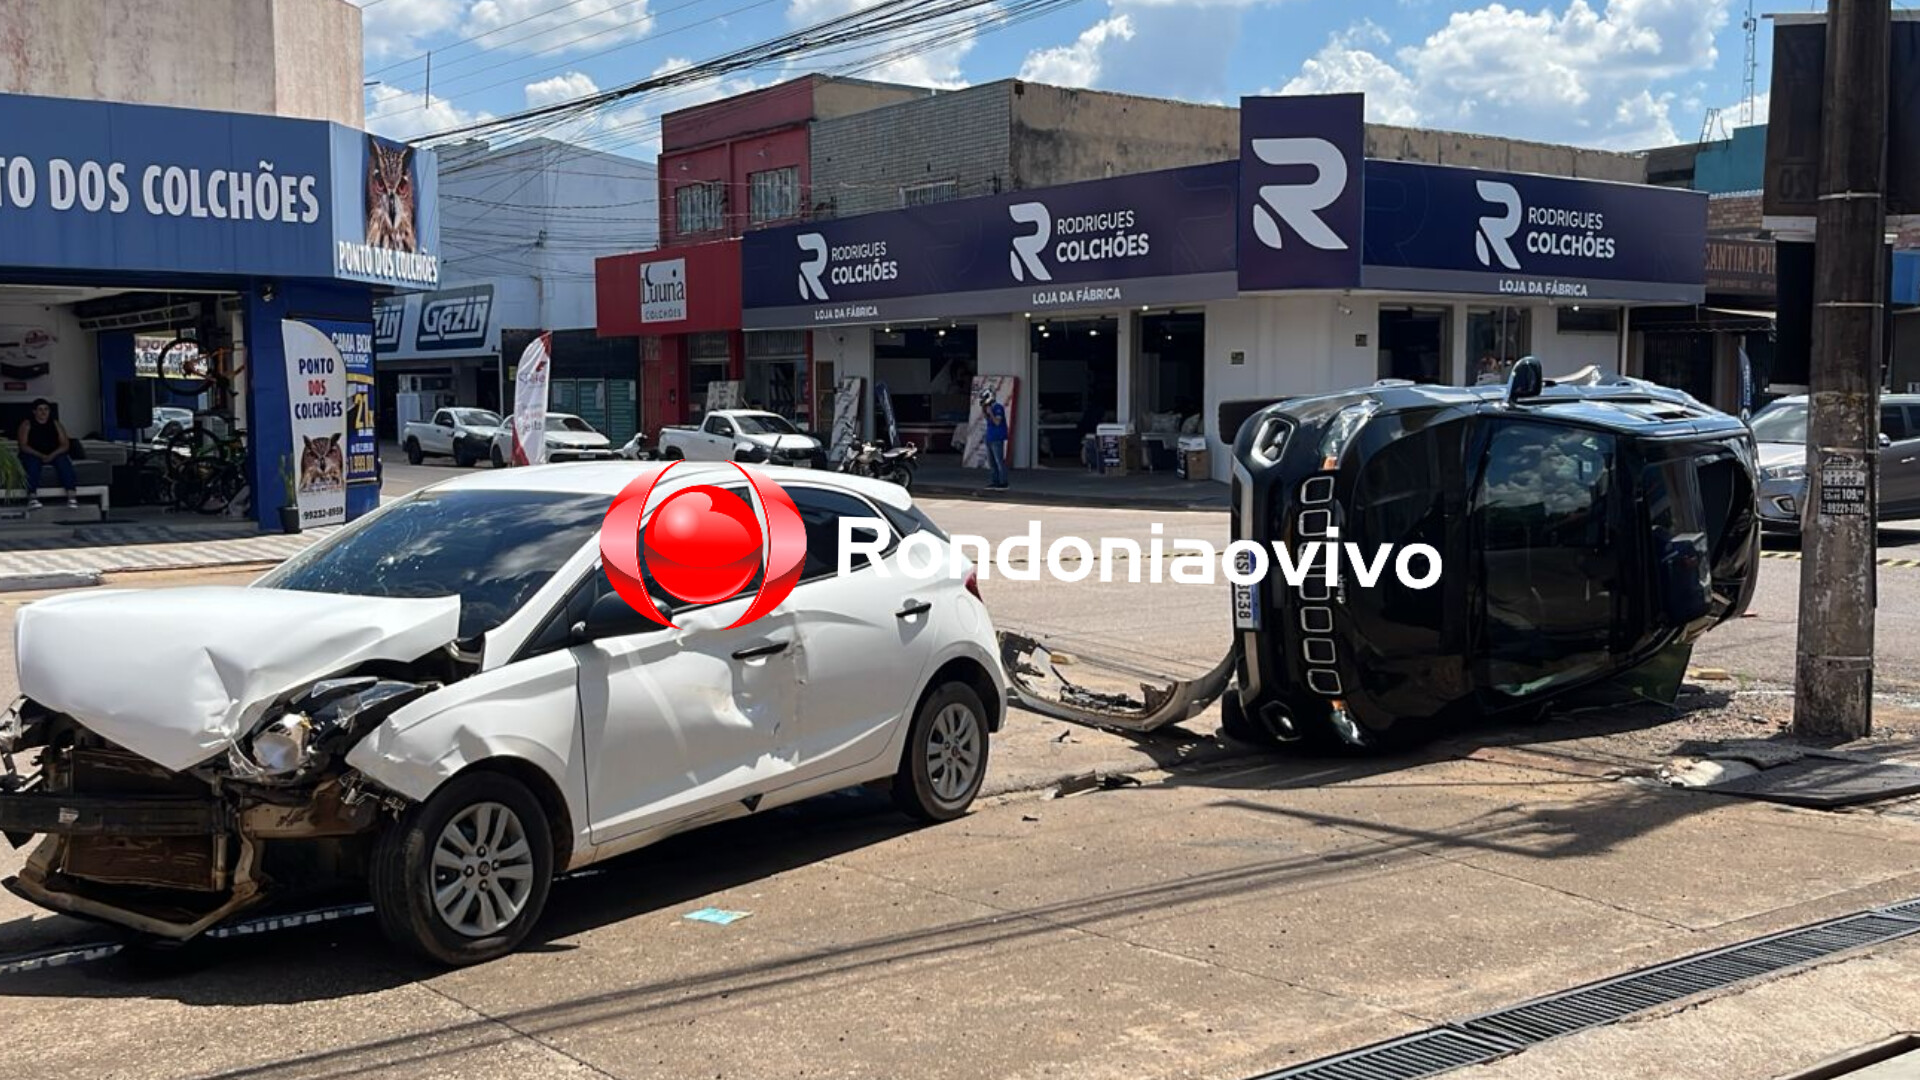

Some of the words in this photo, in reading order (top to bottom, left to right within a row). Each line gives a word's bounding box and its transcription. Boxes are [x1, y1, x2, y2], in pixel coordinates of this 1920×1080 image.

[0, 155, 36, 209] O
[48, 158, 129, 213] DOS
[142, 160, 320, 224] COLCHÕES
[1057, 209, 1135, 235] RODRIGUES
[1528, 206, 1604, 230] RODRIGUES
[831, 241, 887, 261] RODRIGUES
[1056, 230, 1150, 263] COLCHÕES
[1526, 231, 1616, 259] COLCHÕES
[338, 241, 372, 275] PONTO
[374, 246, 395, 277] DOS
[395, 247, 438, 283] COLCHÕES
[831, 258, 898, 285] COLCHÕES
[1032, 291, 1058, 305] LOJA
[1060, 290, 1075, 303] DA
[1076, 286, 1121, 302] FÁBRICA
[1499, 279, 1527, 294] LOJA
[1527, 281, 1543, 294] DA
[1545, 279, 1588, 297] FÁBRICA
[815, 308, 833, 320] LOJA
[834, 308, 845, 319] DA
[846, 304, 878, 318] FÁBRICA
[298, 357, 335, 376] PONTO
[308, 378, 326, 397] DOS
[294, 396, 344, 420] COLCHÕES
